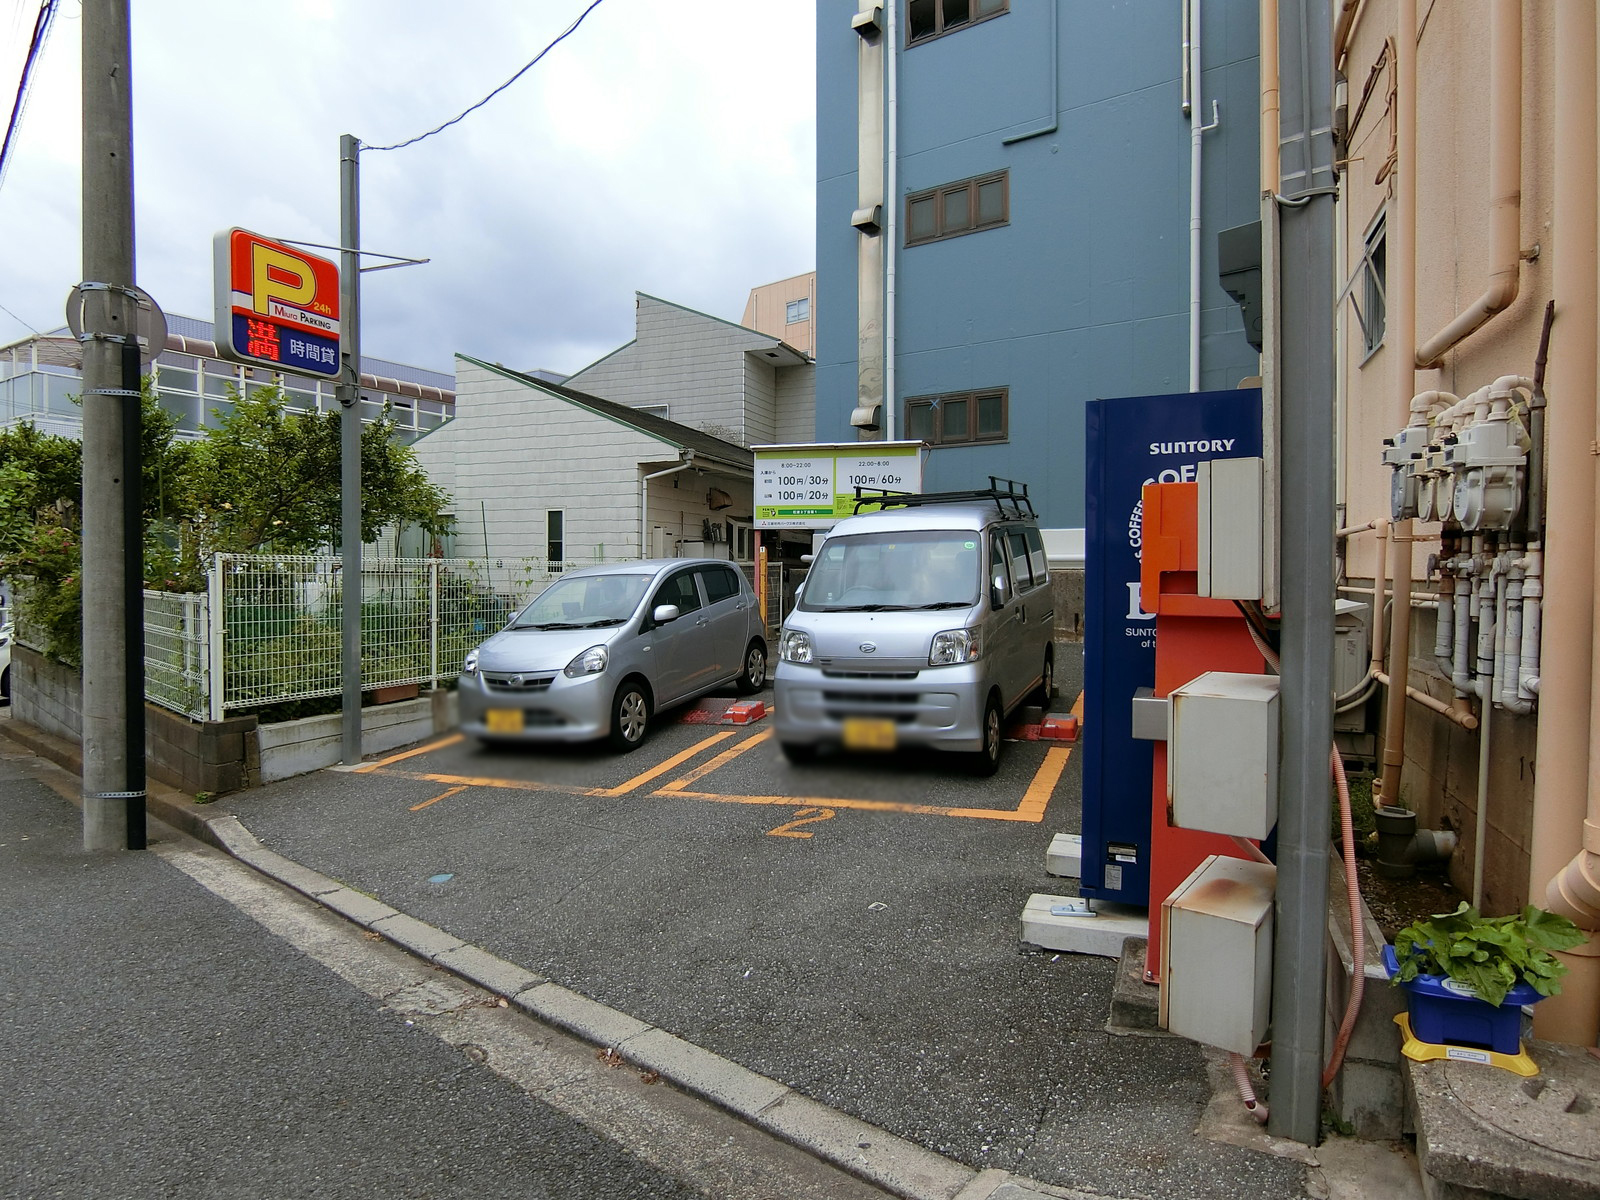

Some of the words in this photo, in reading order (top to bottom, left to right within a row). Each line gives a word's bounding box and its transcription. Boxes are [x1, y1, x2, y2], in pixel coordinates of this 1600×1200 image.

[252, 241, 317, 317] P
[313, 302, 332, 315] 24h
[300, 312, 332, 329] PARKING
[247, 318, 280, 361] 満
[290, 338, 335, 366] 時間貸
[1149, 438, 1236, 455] SUNTORY
[778, 475, 829, 486] 100円/30分
[848, 473, 902, 485] 100円/60分
[778, 490, 829, 501] 100円/20分
[766, 807, 836, 839] 2
